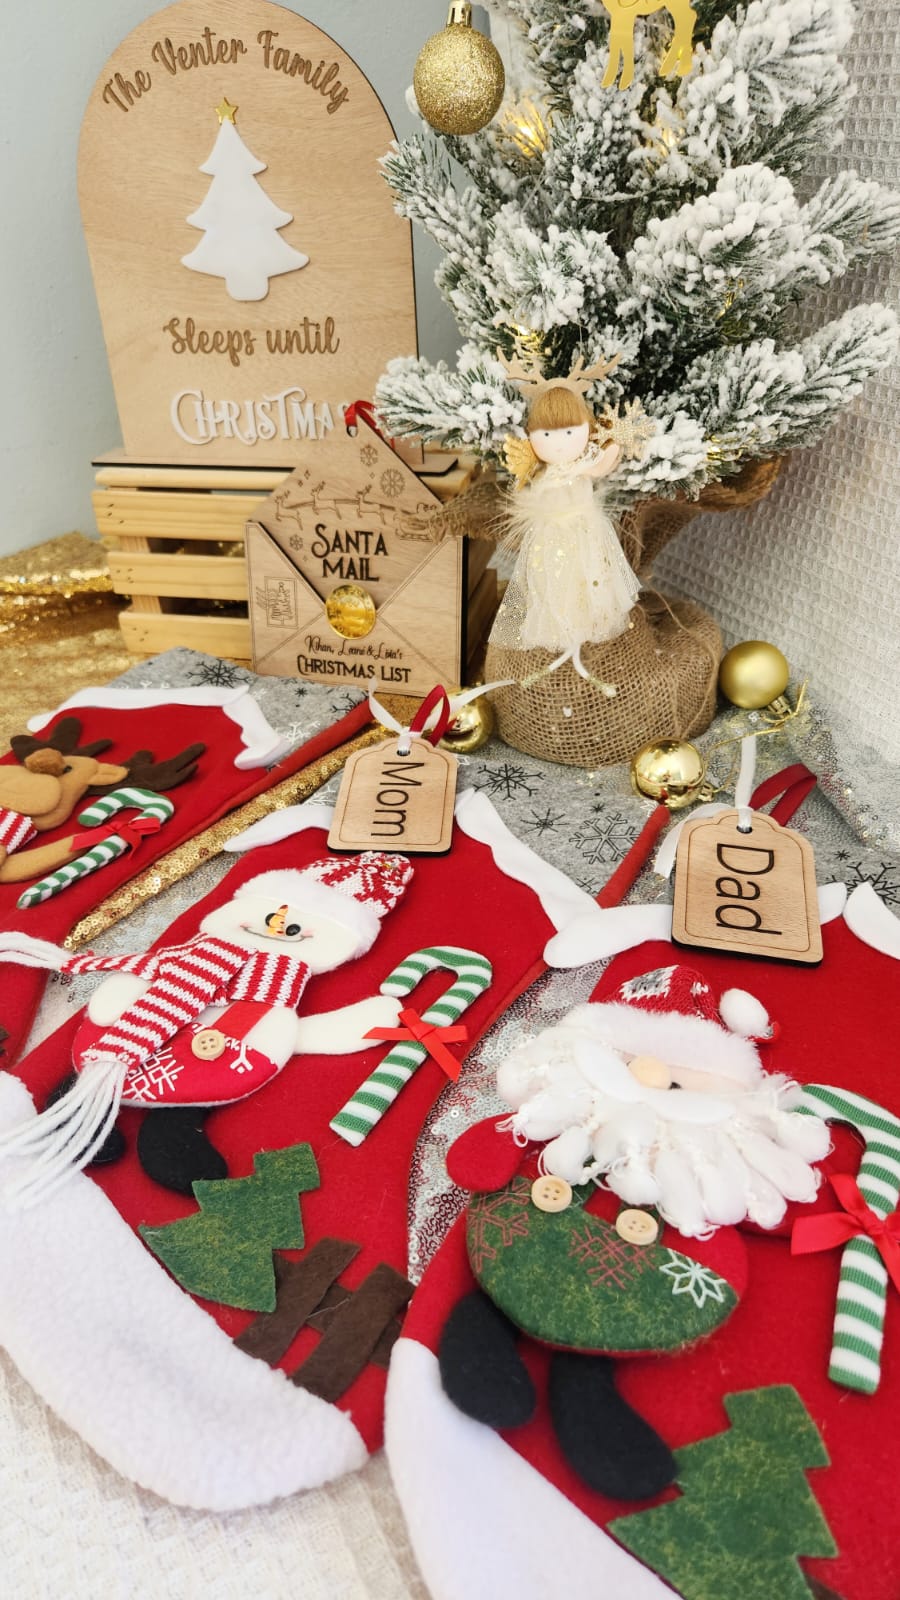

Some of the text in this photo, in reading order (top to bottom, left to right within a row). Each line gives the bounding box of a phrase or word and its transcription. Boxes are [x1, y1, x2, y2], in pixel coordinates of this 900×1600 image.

[102, 26, 349, 114] The Venter Family
[163, 316, 340, 367] Sleeps until
[170, 385, 346, 446] CHRISTMA
[311, 523, 389, 558] SANTA
[322, 556, 379, 582] MAIL
[297, 654, 411, 683] CHRISTMAS LIST
[371, 761, 425, 836] Mom
[715, 843, 782, 935] Dad
